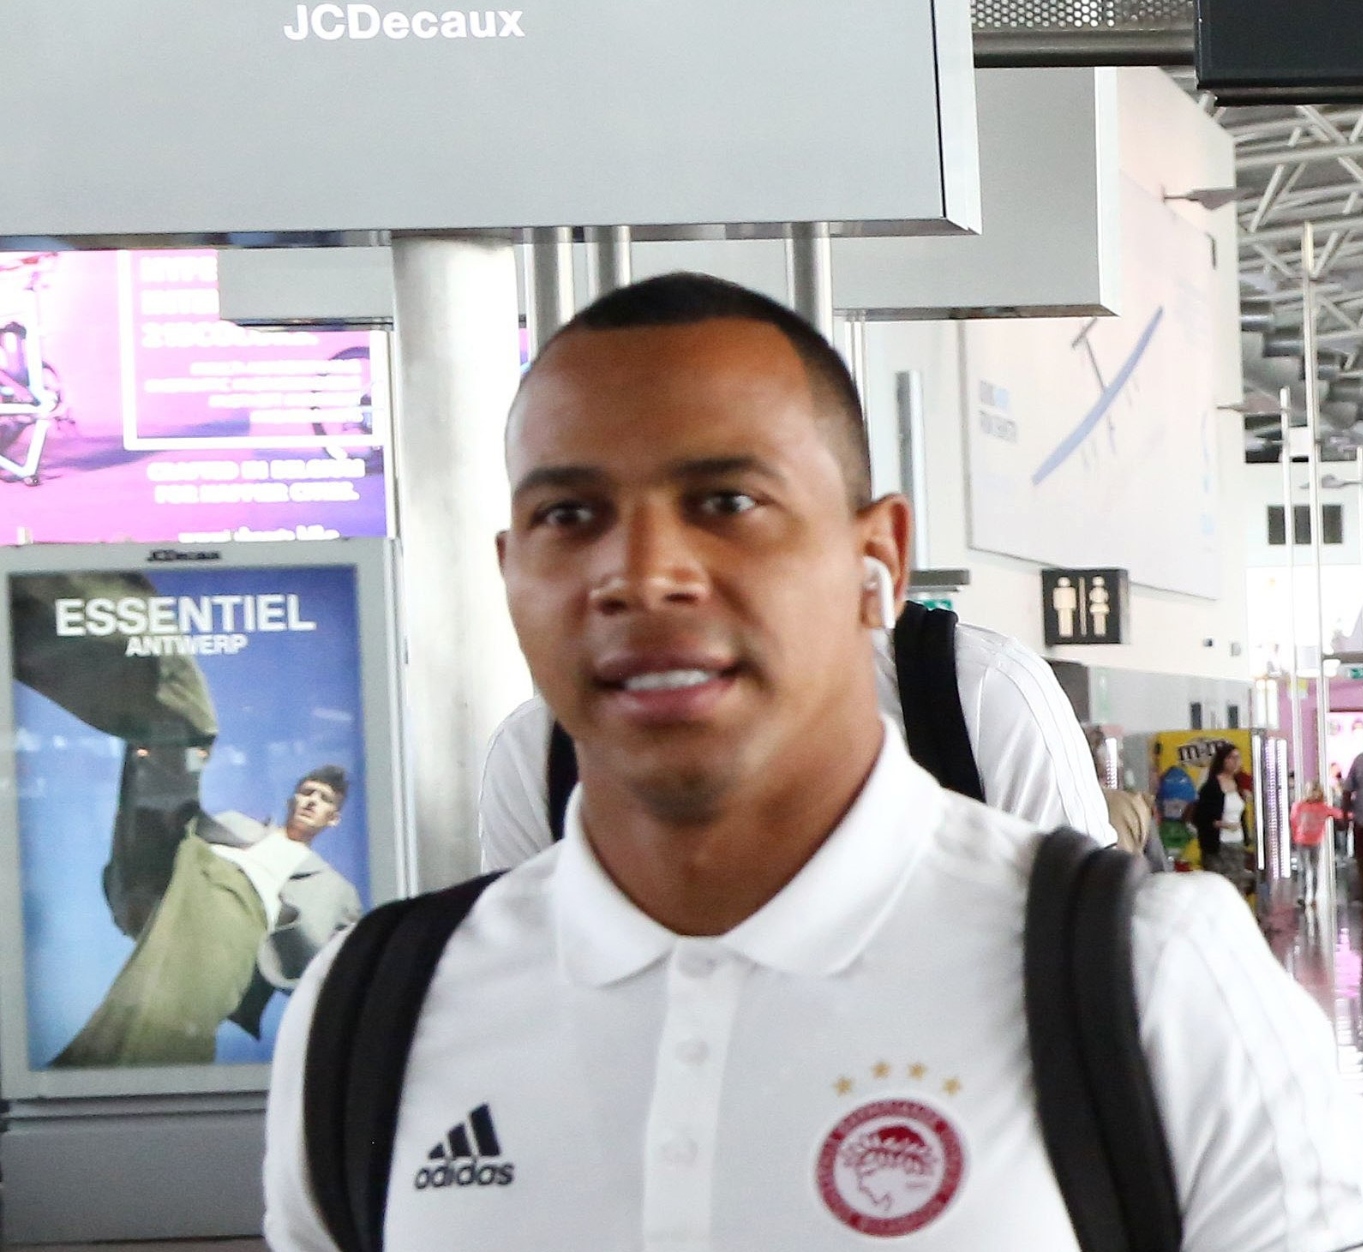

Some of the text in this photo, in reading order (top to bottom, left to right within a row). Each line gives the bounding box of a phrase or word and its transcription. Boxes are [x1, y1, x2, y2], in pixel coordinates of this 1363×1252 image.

[283, 3, 526, 40] JCDecaux
[55, 594, 317, 637] ESSENTIEL
[125, 633, 249, 657] ANTWERP
[415, 1156, 515, 1190] adidas
